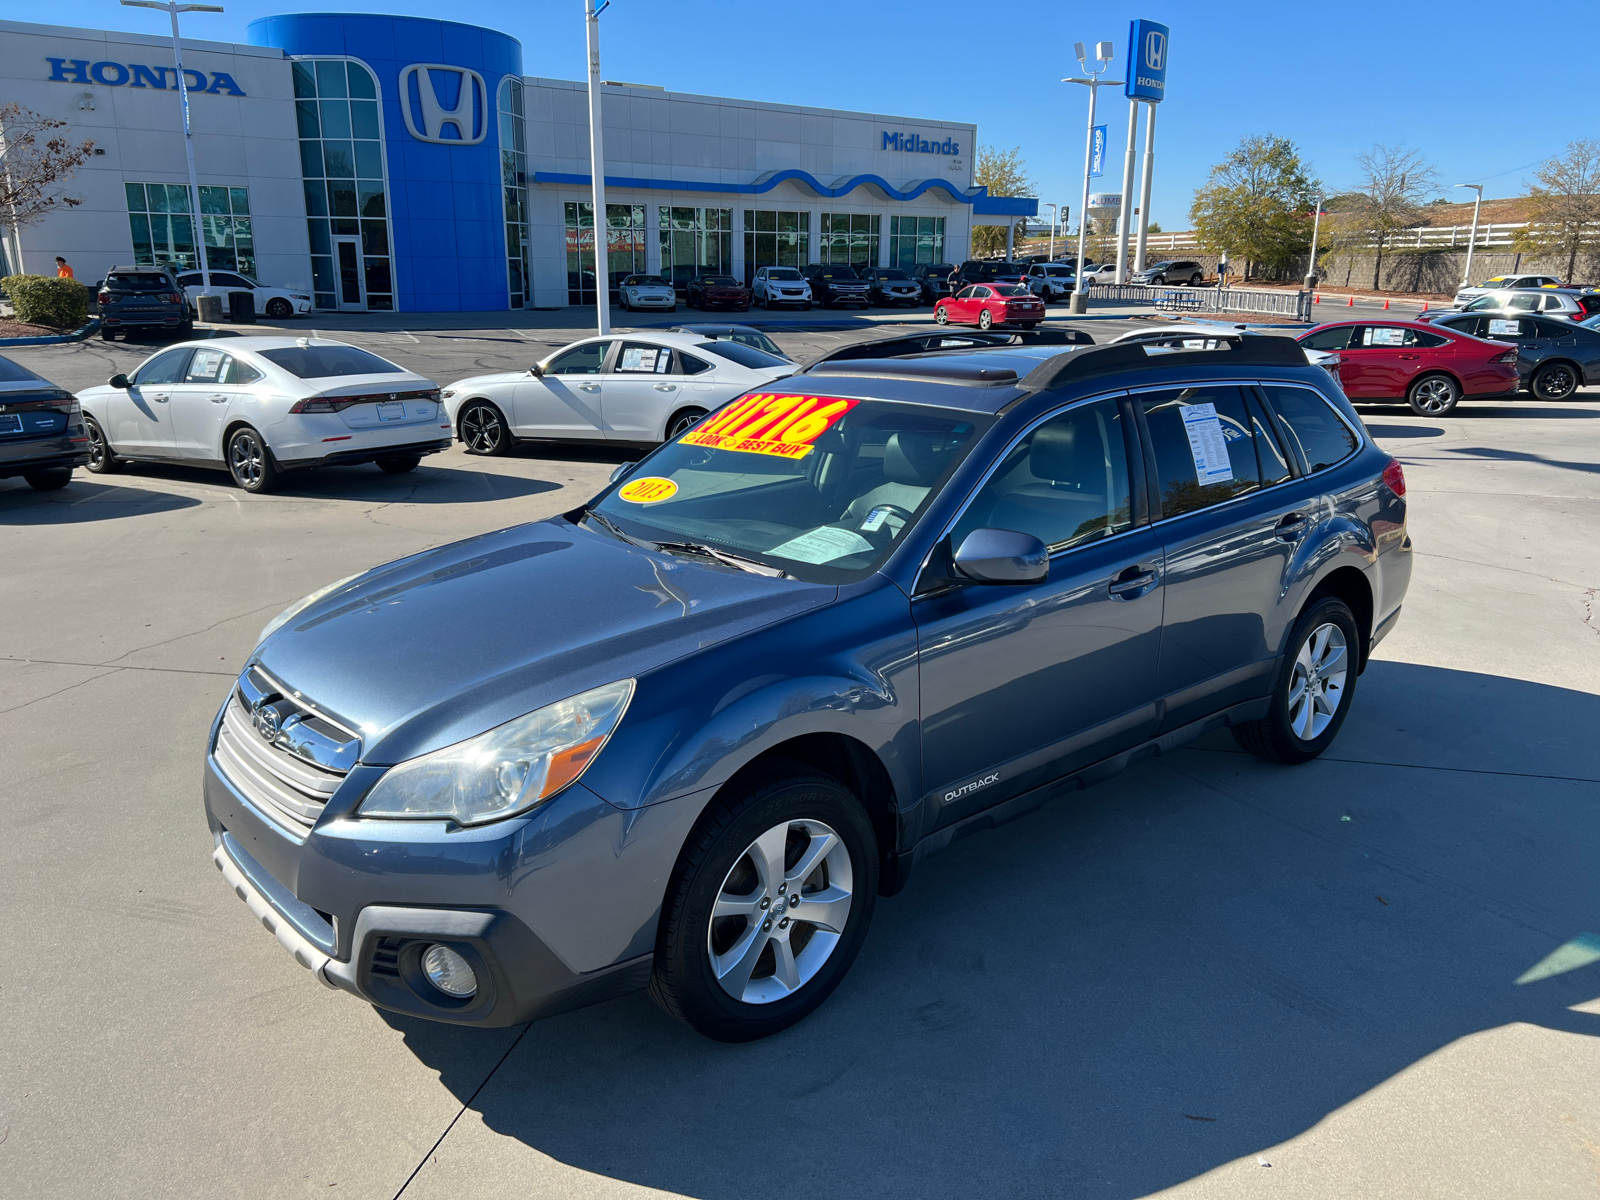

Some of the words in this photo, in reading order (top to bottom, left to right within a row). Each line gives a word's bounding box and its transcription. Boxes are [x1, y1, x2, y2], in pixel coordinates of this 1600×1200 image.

[46, 57, 246, 97] HONDA
[881, 131, 960, 156] Midlands
[1093, 129, 1101, 173] MIDLANDS
[694, 433, 727, 448] LOOK
[734, 440, 770, 454] BEST
[769, 443, 808, 456] BUY
[624, 481, 672, 499] 2013
[944, 772, 1000, 802] OUTBACK
[755, 792, 833, 823] 225/60R17
